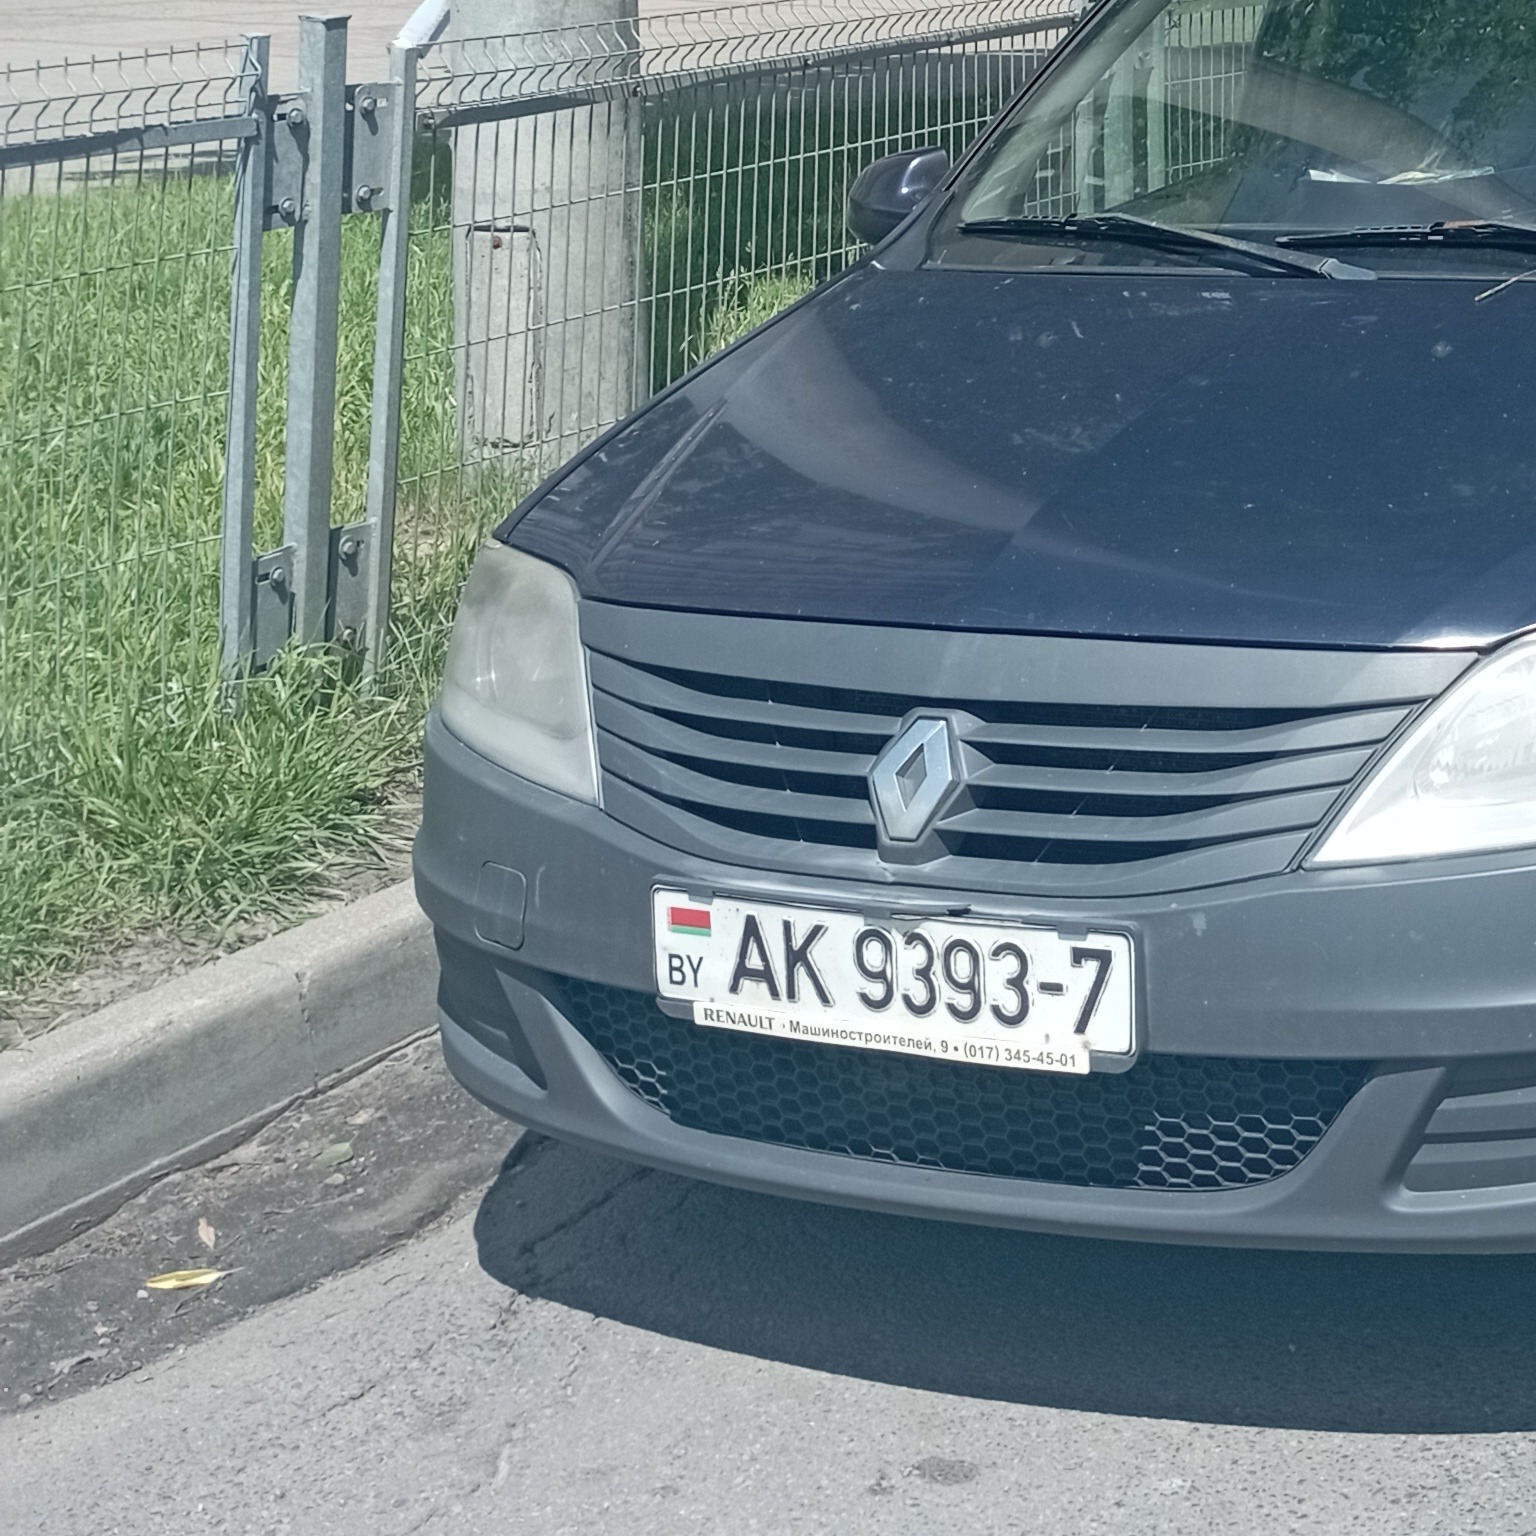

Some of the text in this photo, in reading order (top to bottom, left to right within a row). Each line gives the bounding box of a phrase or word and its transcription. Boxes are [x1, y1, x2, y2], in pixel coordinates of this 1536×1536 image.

[667, 952, 704, 988] BY
[853, 926, 1114, 1035] 9393-7
[702, 1007, 776, 1031] RENAULT
[789, 1019, 937, 1054] Машиностроителей,
[963, 1041, 1000, 1062] (017)
[1004, 1047, 1077, 1068] 345-45-01
